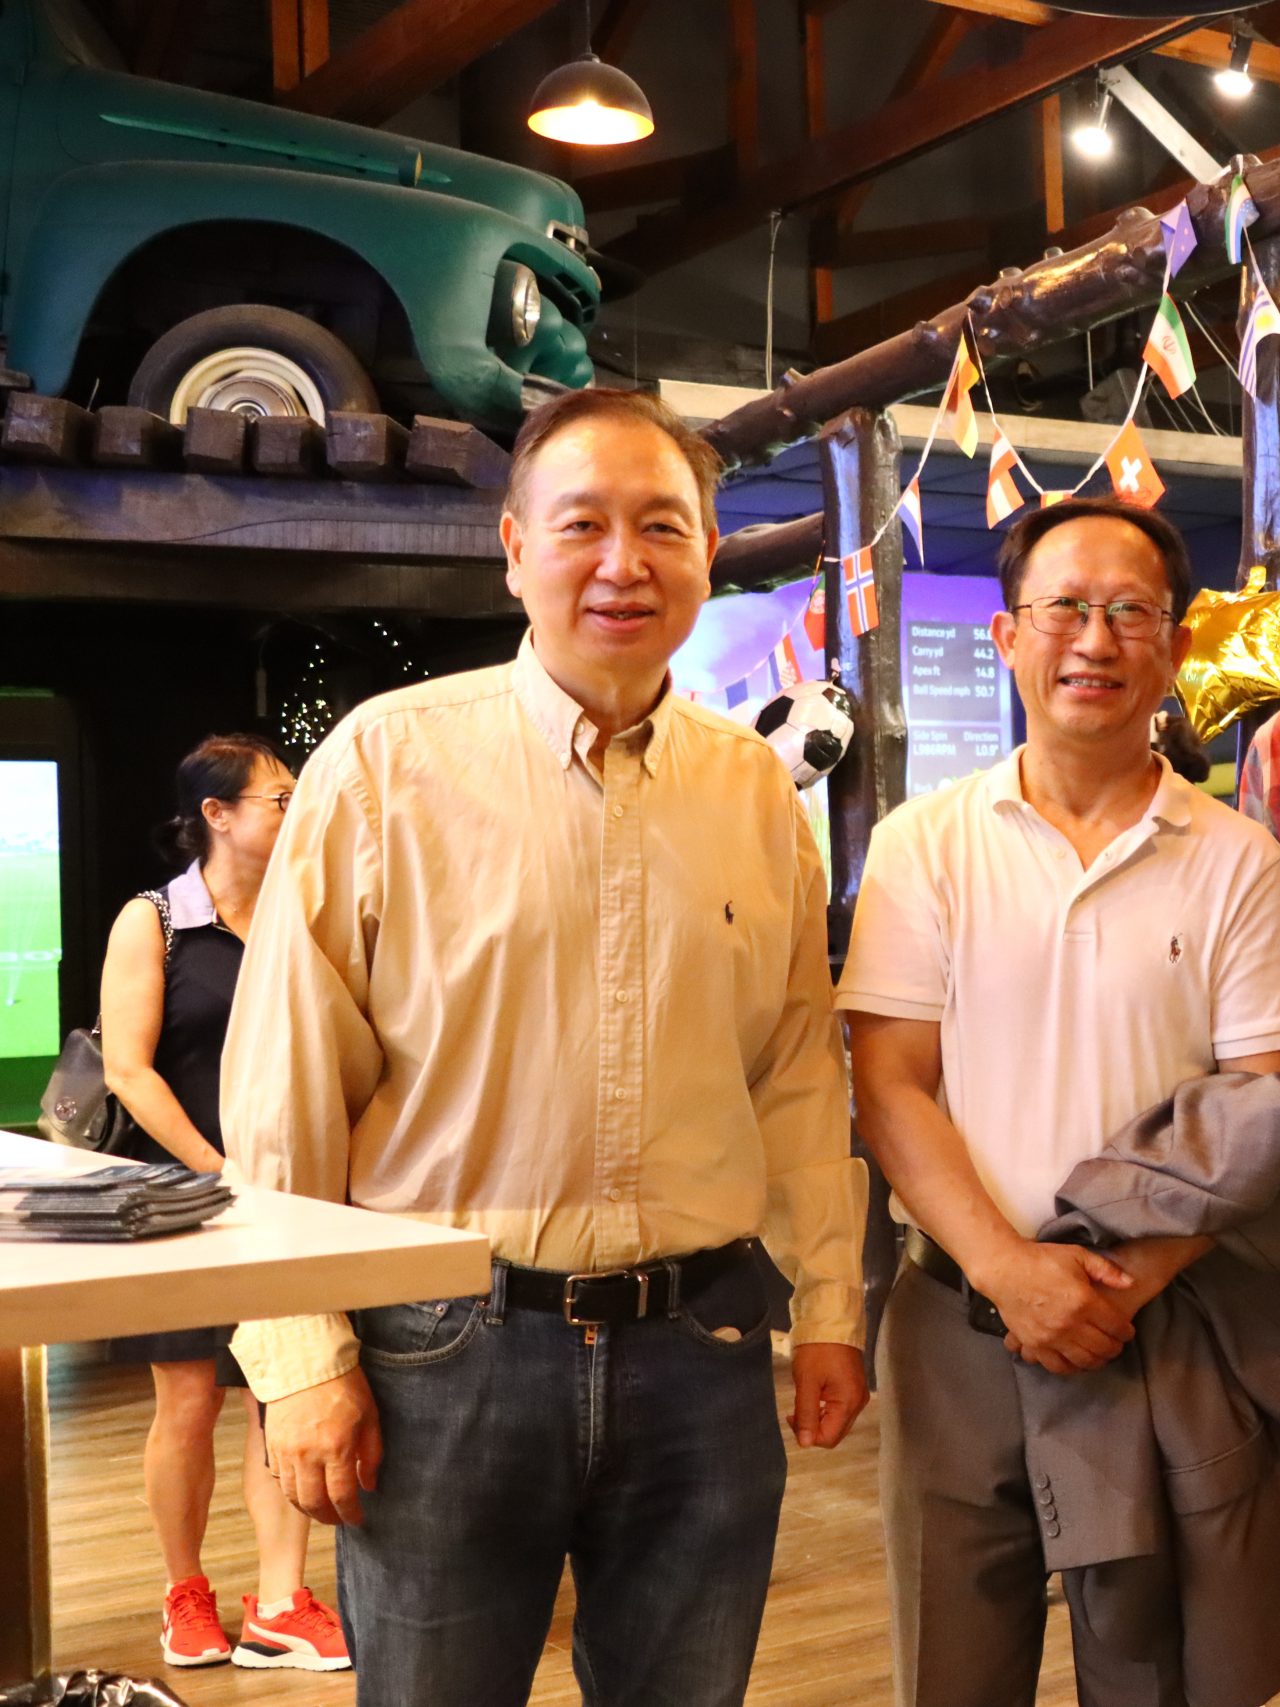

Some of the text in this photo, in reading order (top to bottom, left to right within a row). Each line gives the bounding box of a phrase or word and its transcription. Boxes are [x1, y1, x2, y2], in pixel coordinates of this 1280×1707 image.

[912, 626, 945, 638] Distance
[945, 628, 956, 640] yd
[912, 645, 994, 660] Carry yd 44.2
[912, 665, 932, 677] Apex
[975, 666, 995, 679] 14.8
[912, 683, 995, 698] Ball Speed mph 50.7
[930, 731, 948, 742] Spin
[963, 731, 999, 742] Direction
